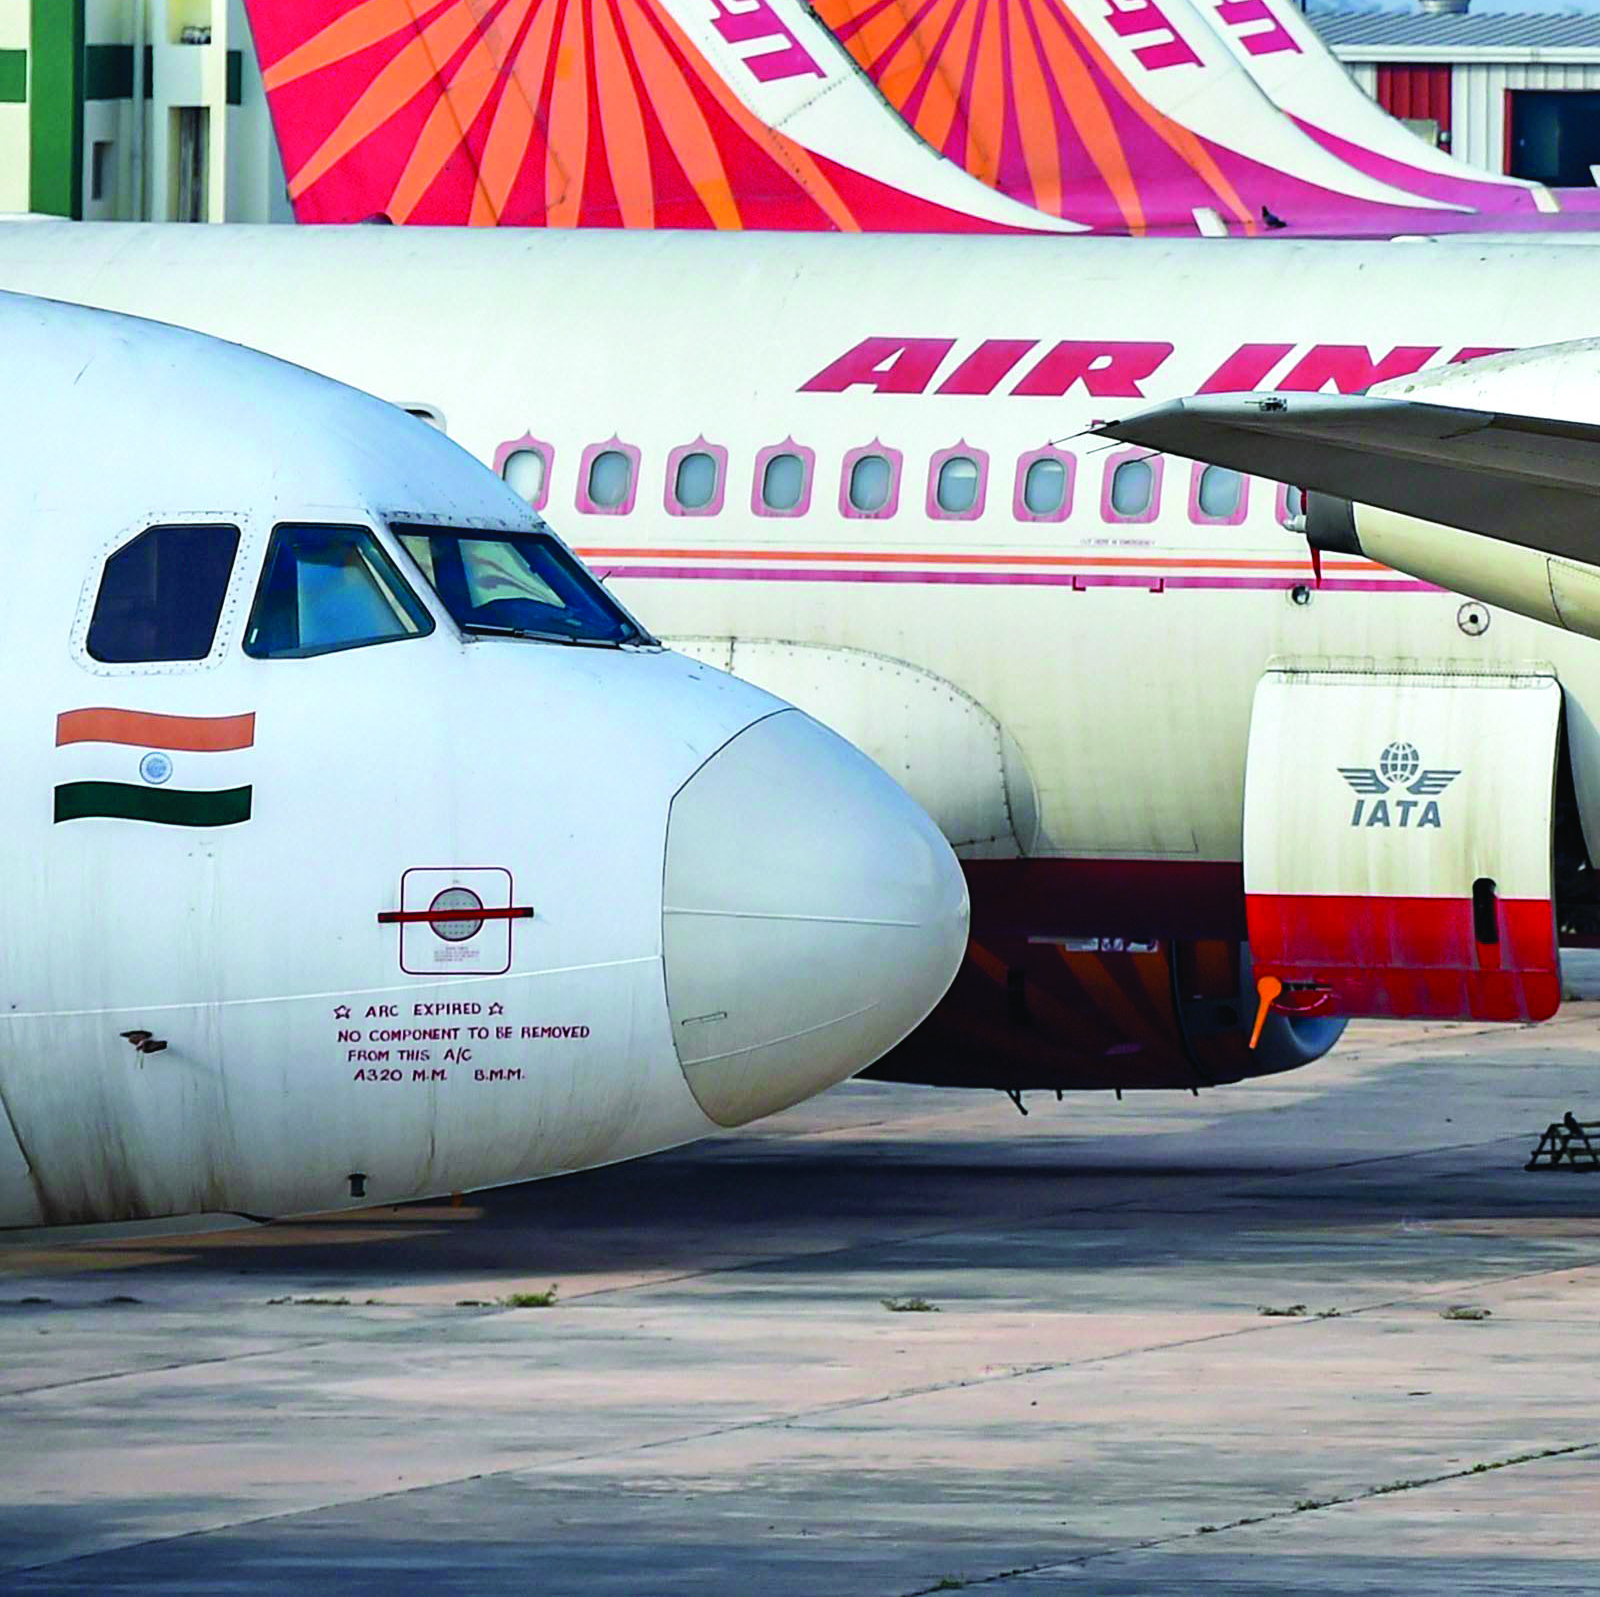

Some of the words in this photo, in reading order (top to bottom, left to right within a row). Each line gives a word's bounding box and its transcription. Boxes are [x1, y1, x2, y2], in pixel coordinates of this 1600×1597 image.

[796, 337, 1175, 398] AIR
[1195, 344, 1517, 396] IN
[1351, 799, 1441, 827] IATA
[365, 1004, 399, 1018] ARC
[413, 1002, 482, 1017] EXPIRED
[337, 1030, 361, 1043] NO
[369, 1027, 460, 1042] COMPONENT
[467, 1026, 489, 1040] TO
[496, 1026, 513, 1039] BE
[521, 1025, 590, 1039] REMOVED
[348, 1049, 390, 1062] FROM
[397, 1049, 430, 1062] THIS
[444, 1047, 472, 1065] A/C
[353, 1069, 403, 1082] A320
